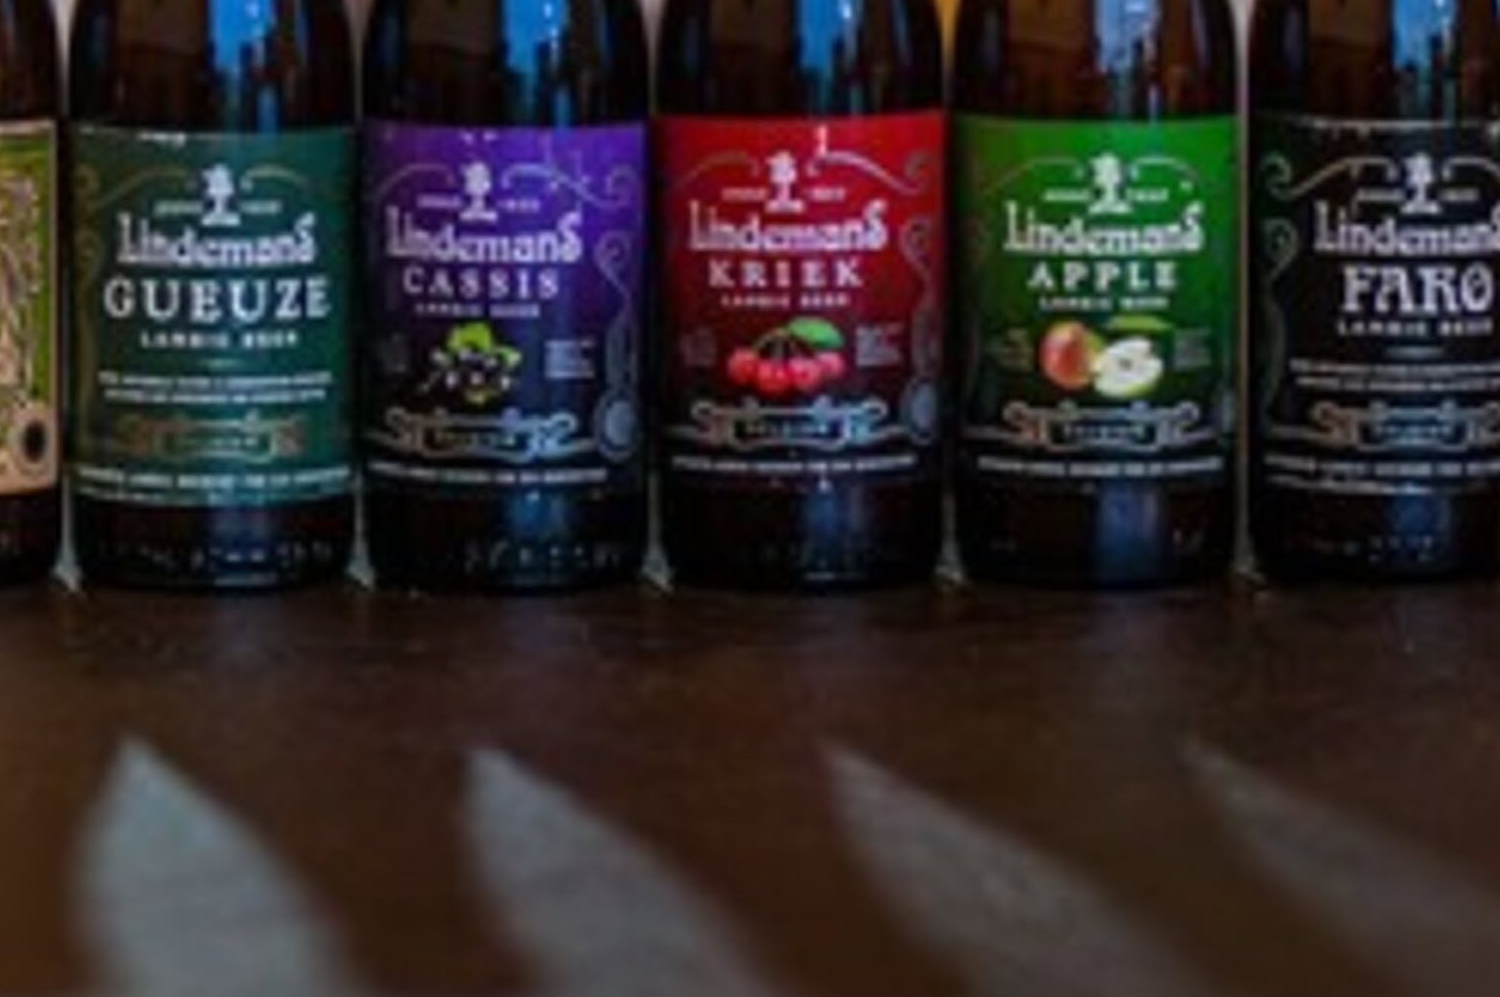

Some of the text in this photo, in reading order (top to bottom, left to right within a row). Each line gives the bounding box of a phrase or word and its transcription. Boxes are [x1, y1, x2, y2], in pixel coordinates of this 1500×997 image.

[401, 265, 560, 300] CASSIS
[708, 258, 864, 288] KRIEK
[1026, 259, 1179, 292] APPLE
[1341, 262, 1494, 315] FARO
[103, 277, 332, 324] GUEUZE
